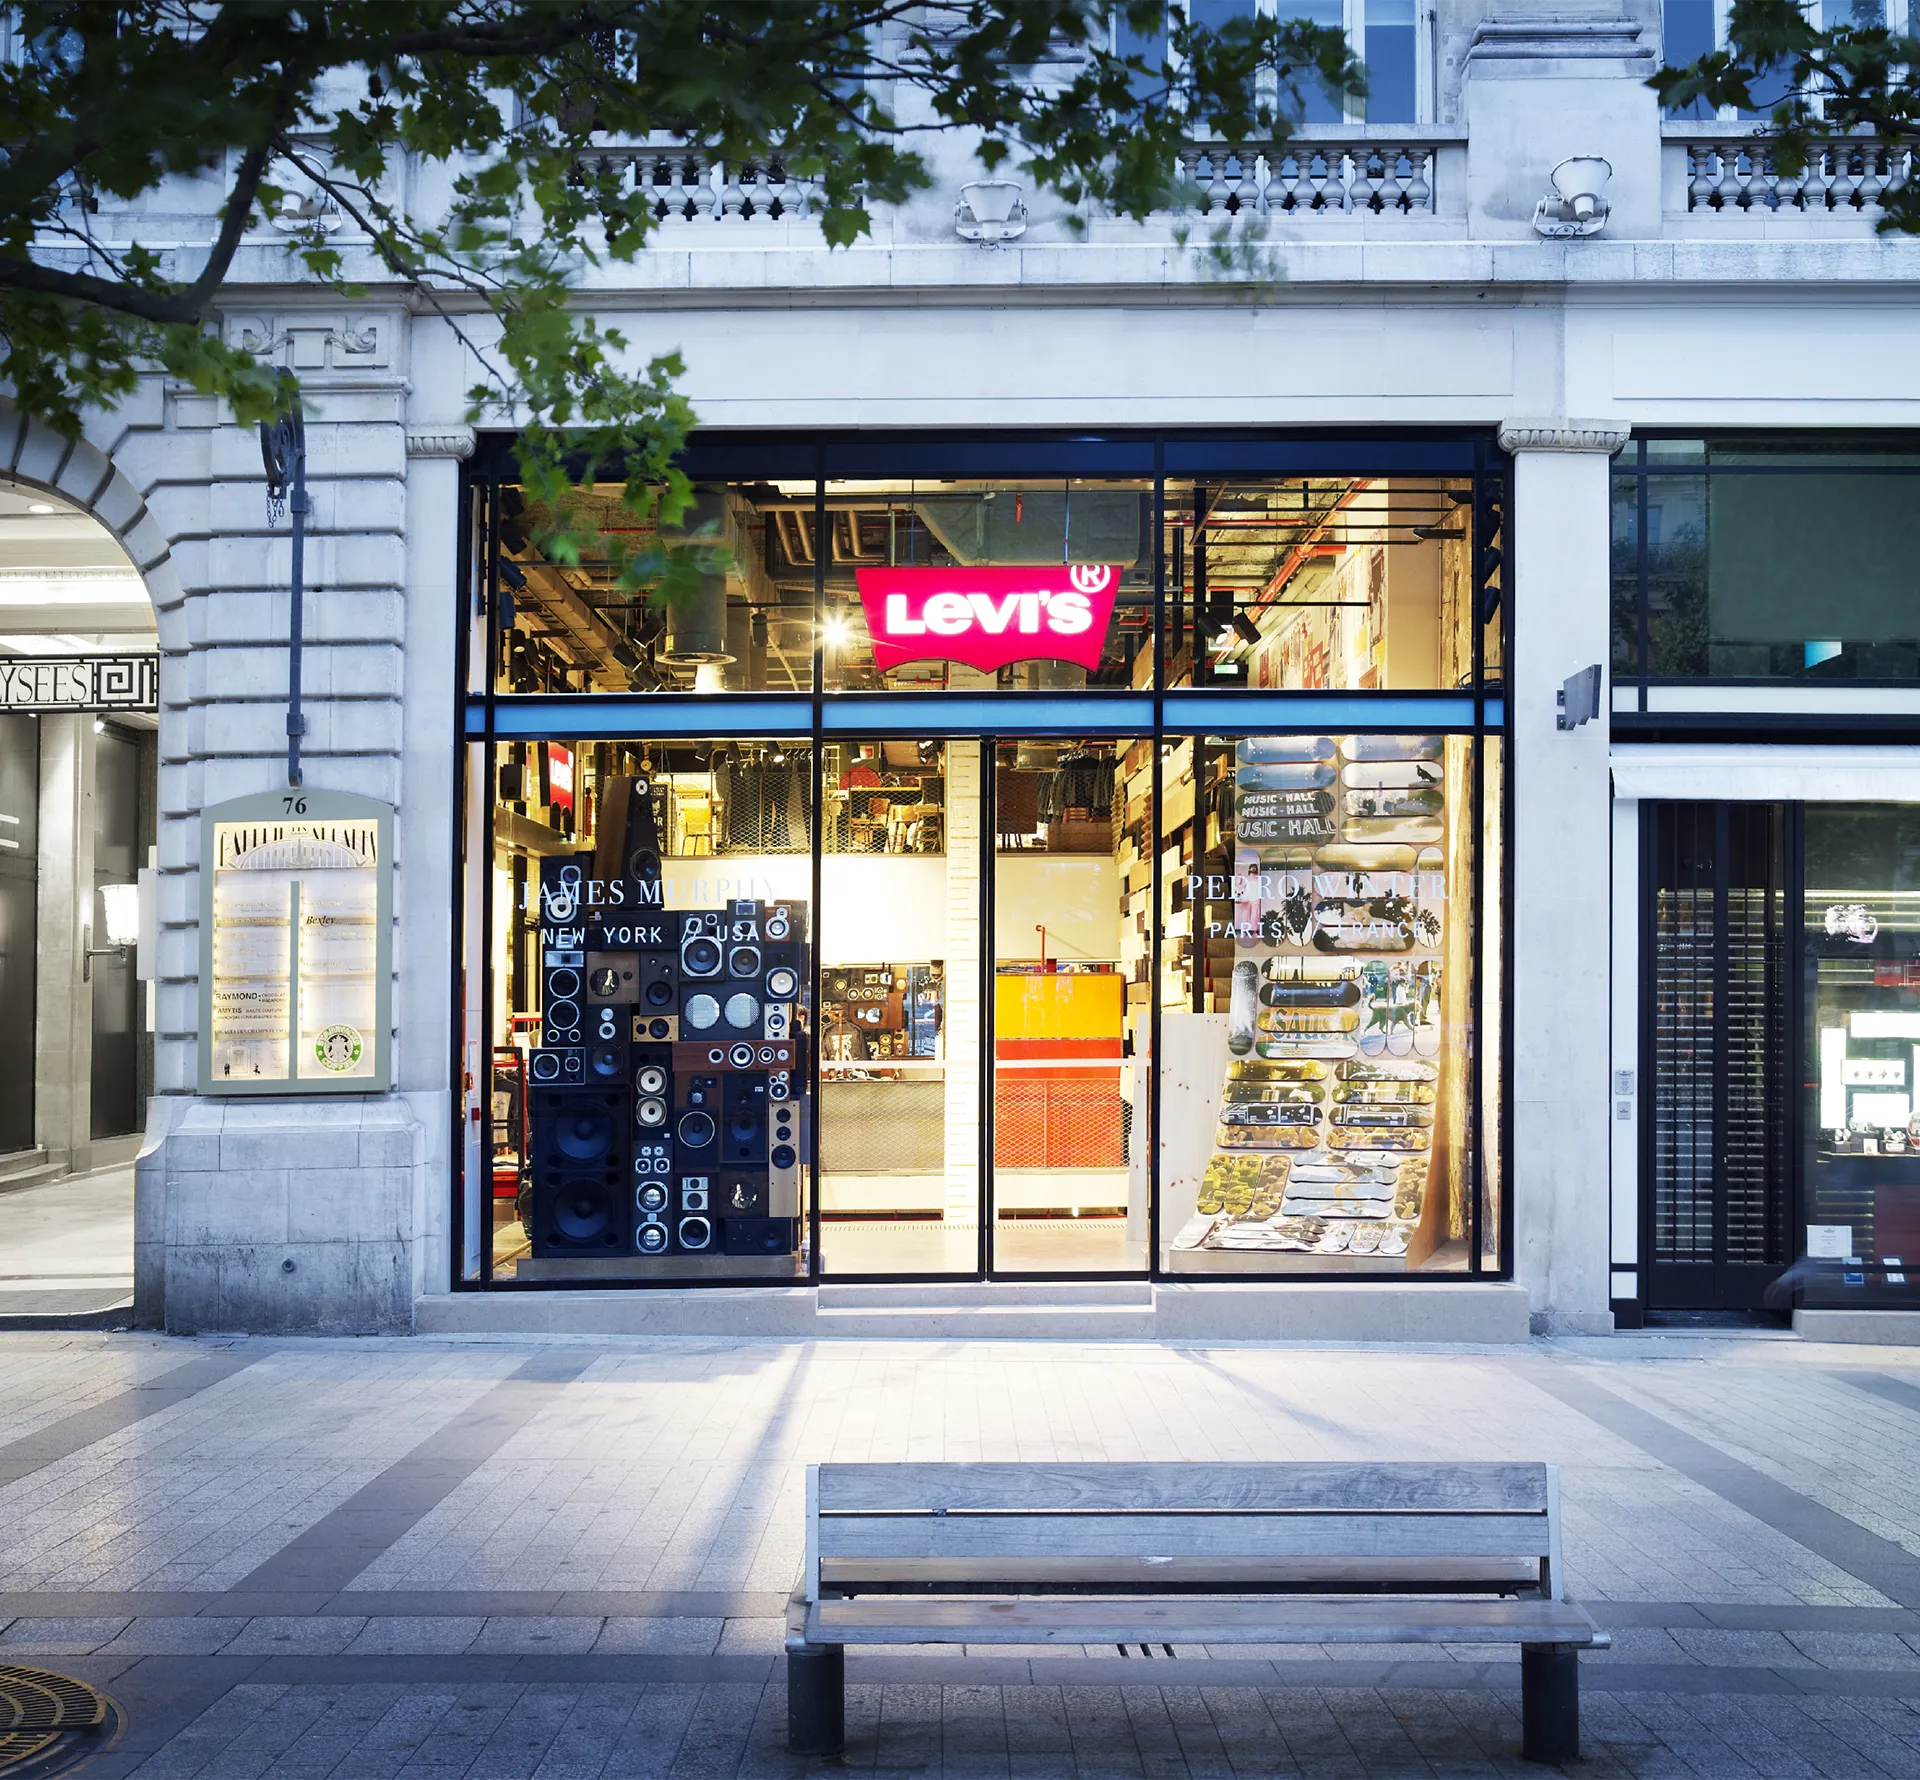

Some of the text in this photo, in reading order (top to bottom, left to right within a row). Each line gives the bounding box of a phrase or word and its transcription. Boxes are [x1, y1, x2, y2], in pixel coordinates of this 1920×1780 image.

[0, 664, 87, 702] YSEES
[282, 796, 307, 815] 76
[1243, 795, 1277, 805] MUSIC
[1286, 792, 1316, 803] HALL
[1241, 806, 1277, 818] MUSIC
[1286, 803, 1319, 815] HALL
[1236, 820, 1278, 838] USIC
[1288, 818, 1336, 836] HALL
[518, 878, 776, 910] JAMES MURPHY
[1186, 874, 1450, 900] PEDRO WINTER
[306, 915, 336, 927] Bexley
[1210, 921, 1284, 939] PARIS
[1337, 920, 1426, 939] FRANCE
[541, 927, 586, 945] NEW
[603, 926, 663, 944] YORK
[716, 925, 760, 943] USA
[216, 992, 258, 1001] RAYMOND
